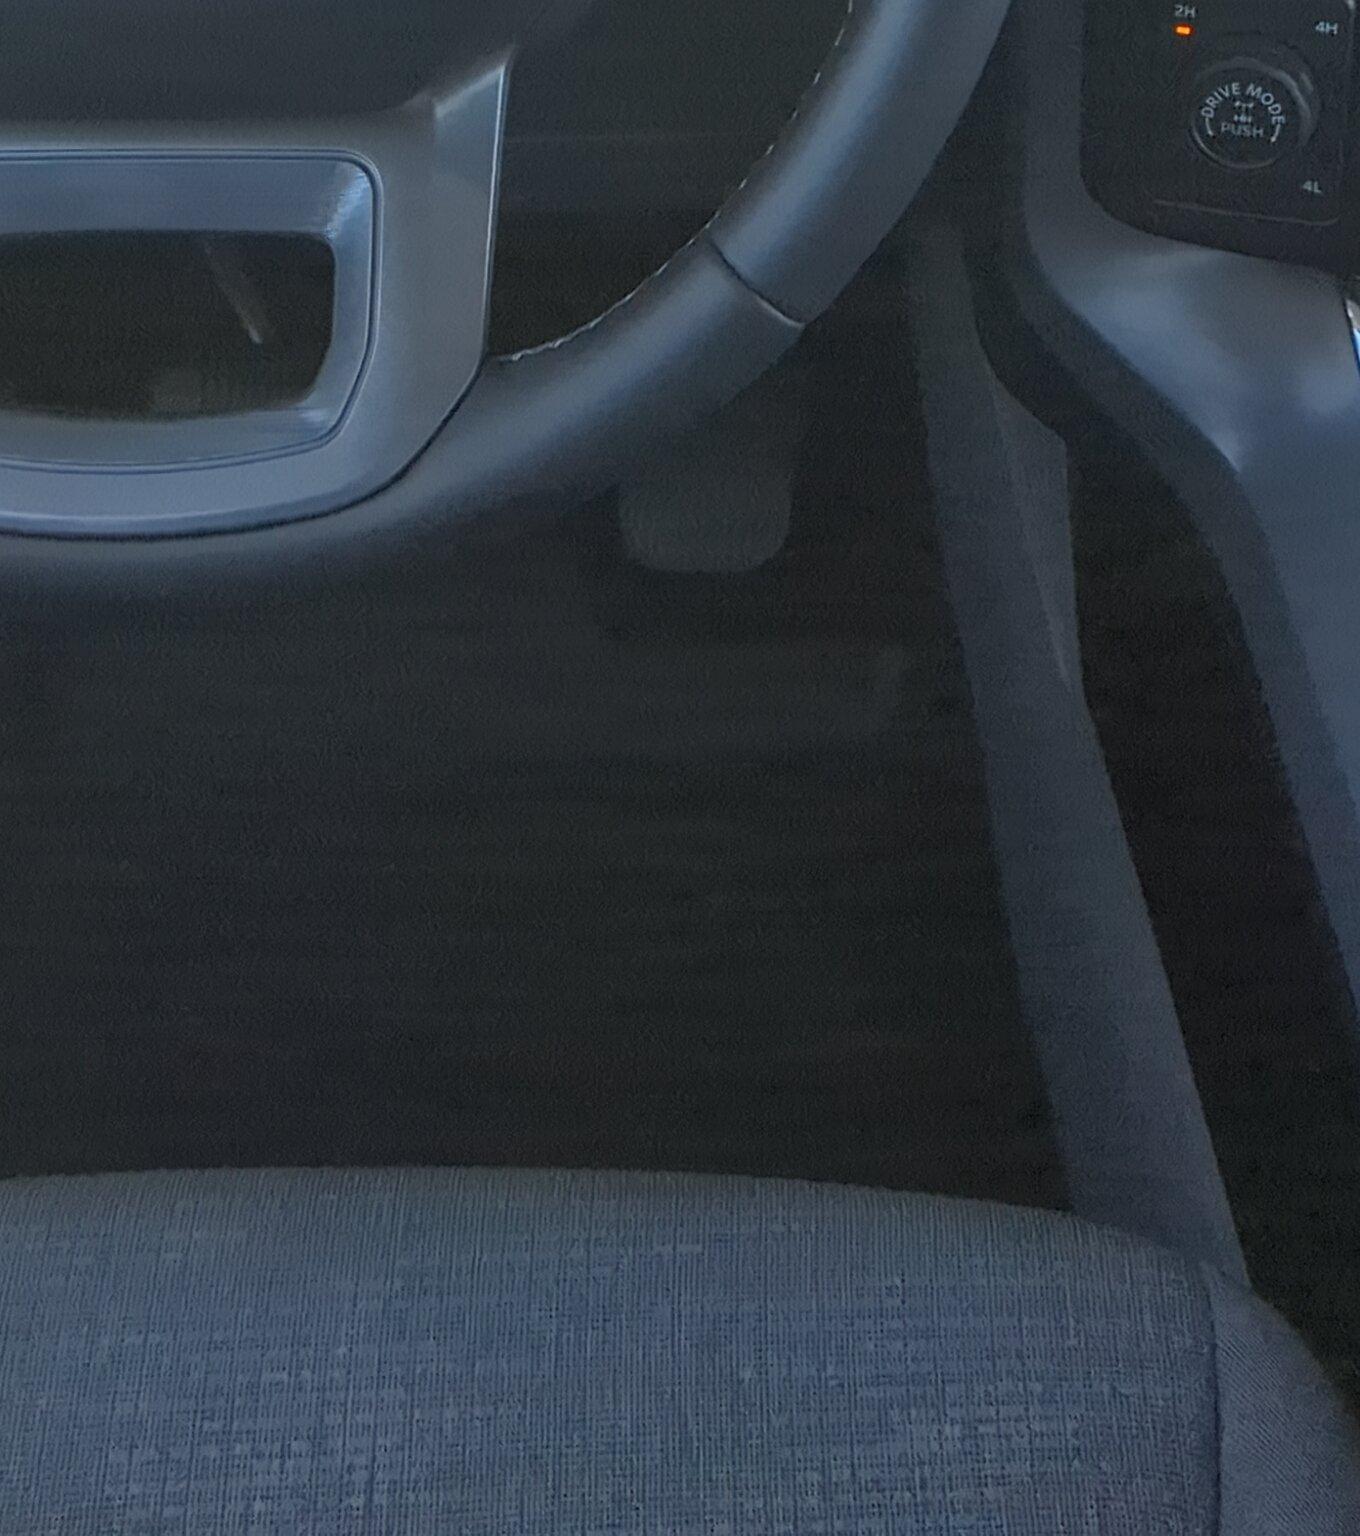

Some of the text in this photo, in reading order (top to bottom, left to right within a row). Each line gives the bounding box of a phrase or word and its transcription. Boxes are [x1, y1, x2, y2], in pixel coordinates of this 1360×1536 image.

[1173, 4, 1196, 19] 2H
[1315, 21, 1338, 35] 4H
[1200, 82, 1286, 125] DRIVE MODE
[1220, 122, 1264, 138] PUSH
[1301, 181, 1323, 195] 4L
